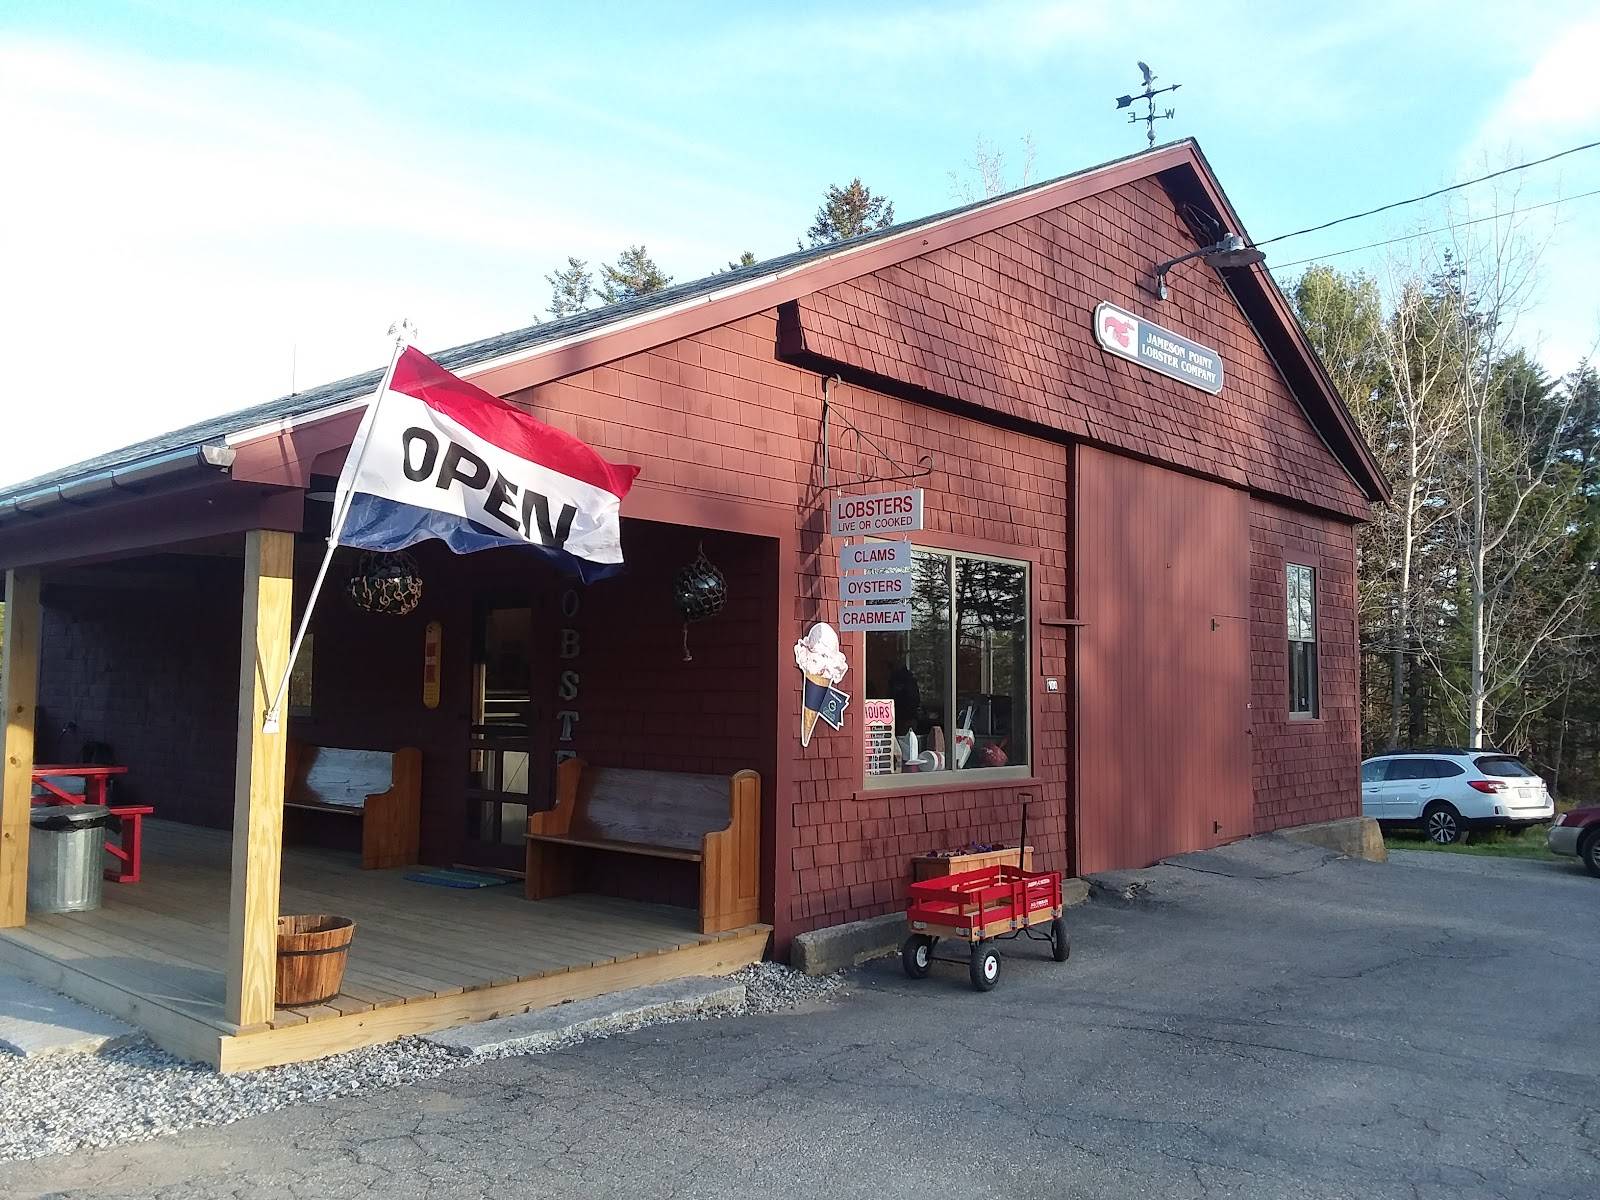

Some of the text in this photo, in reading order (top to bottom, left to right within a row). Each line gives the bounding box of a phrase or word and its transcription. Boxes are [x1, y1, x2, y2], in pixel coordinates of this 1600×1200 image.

[1146, 332, 1213, 370] JAMESON POINT
[1141, 343, 1217, 384] LOBSTER COMPANY
[402, 426, 578, 550] OPEN
[838, 495, 913, 520] LOBSTERS
[838, 516, 913, 532] LIVE OR COOKED
[854, 548, 896, 563] CLAMS
[848, 580, 902, 594] OYSTERS
[843, 611, 906, 625] CRABMEAT
